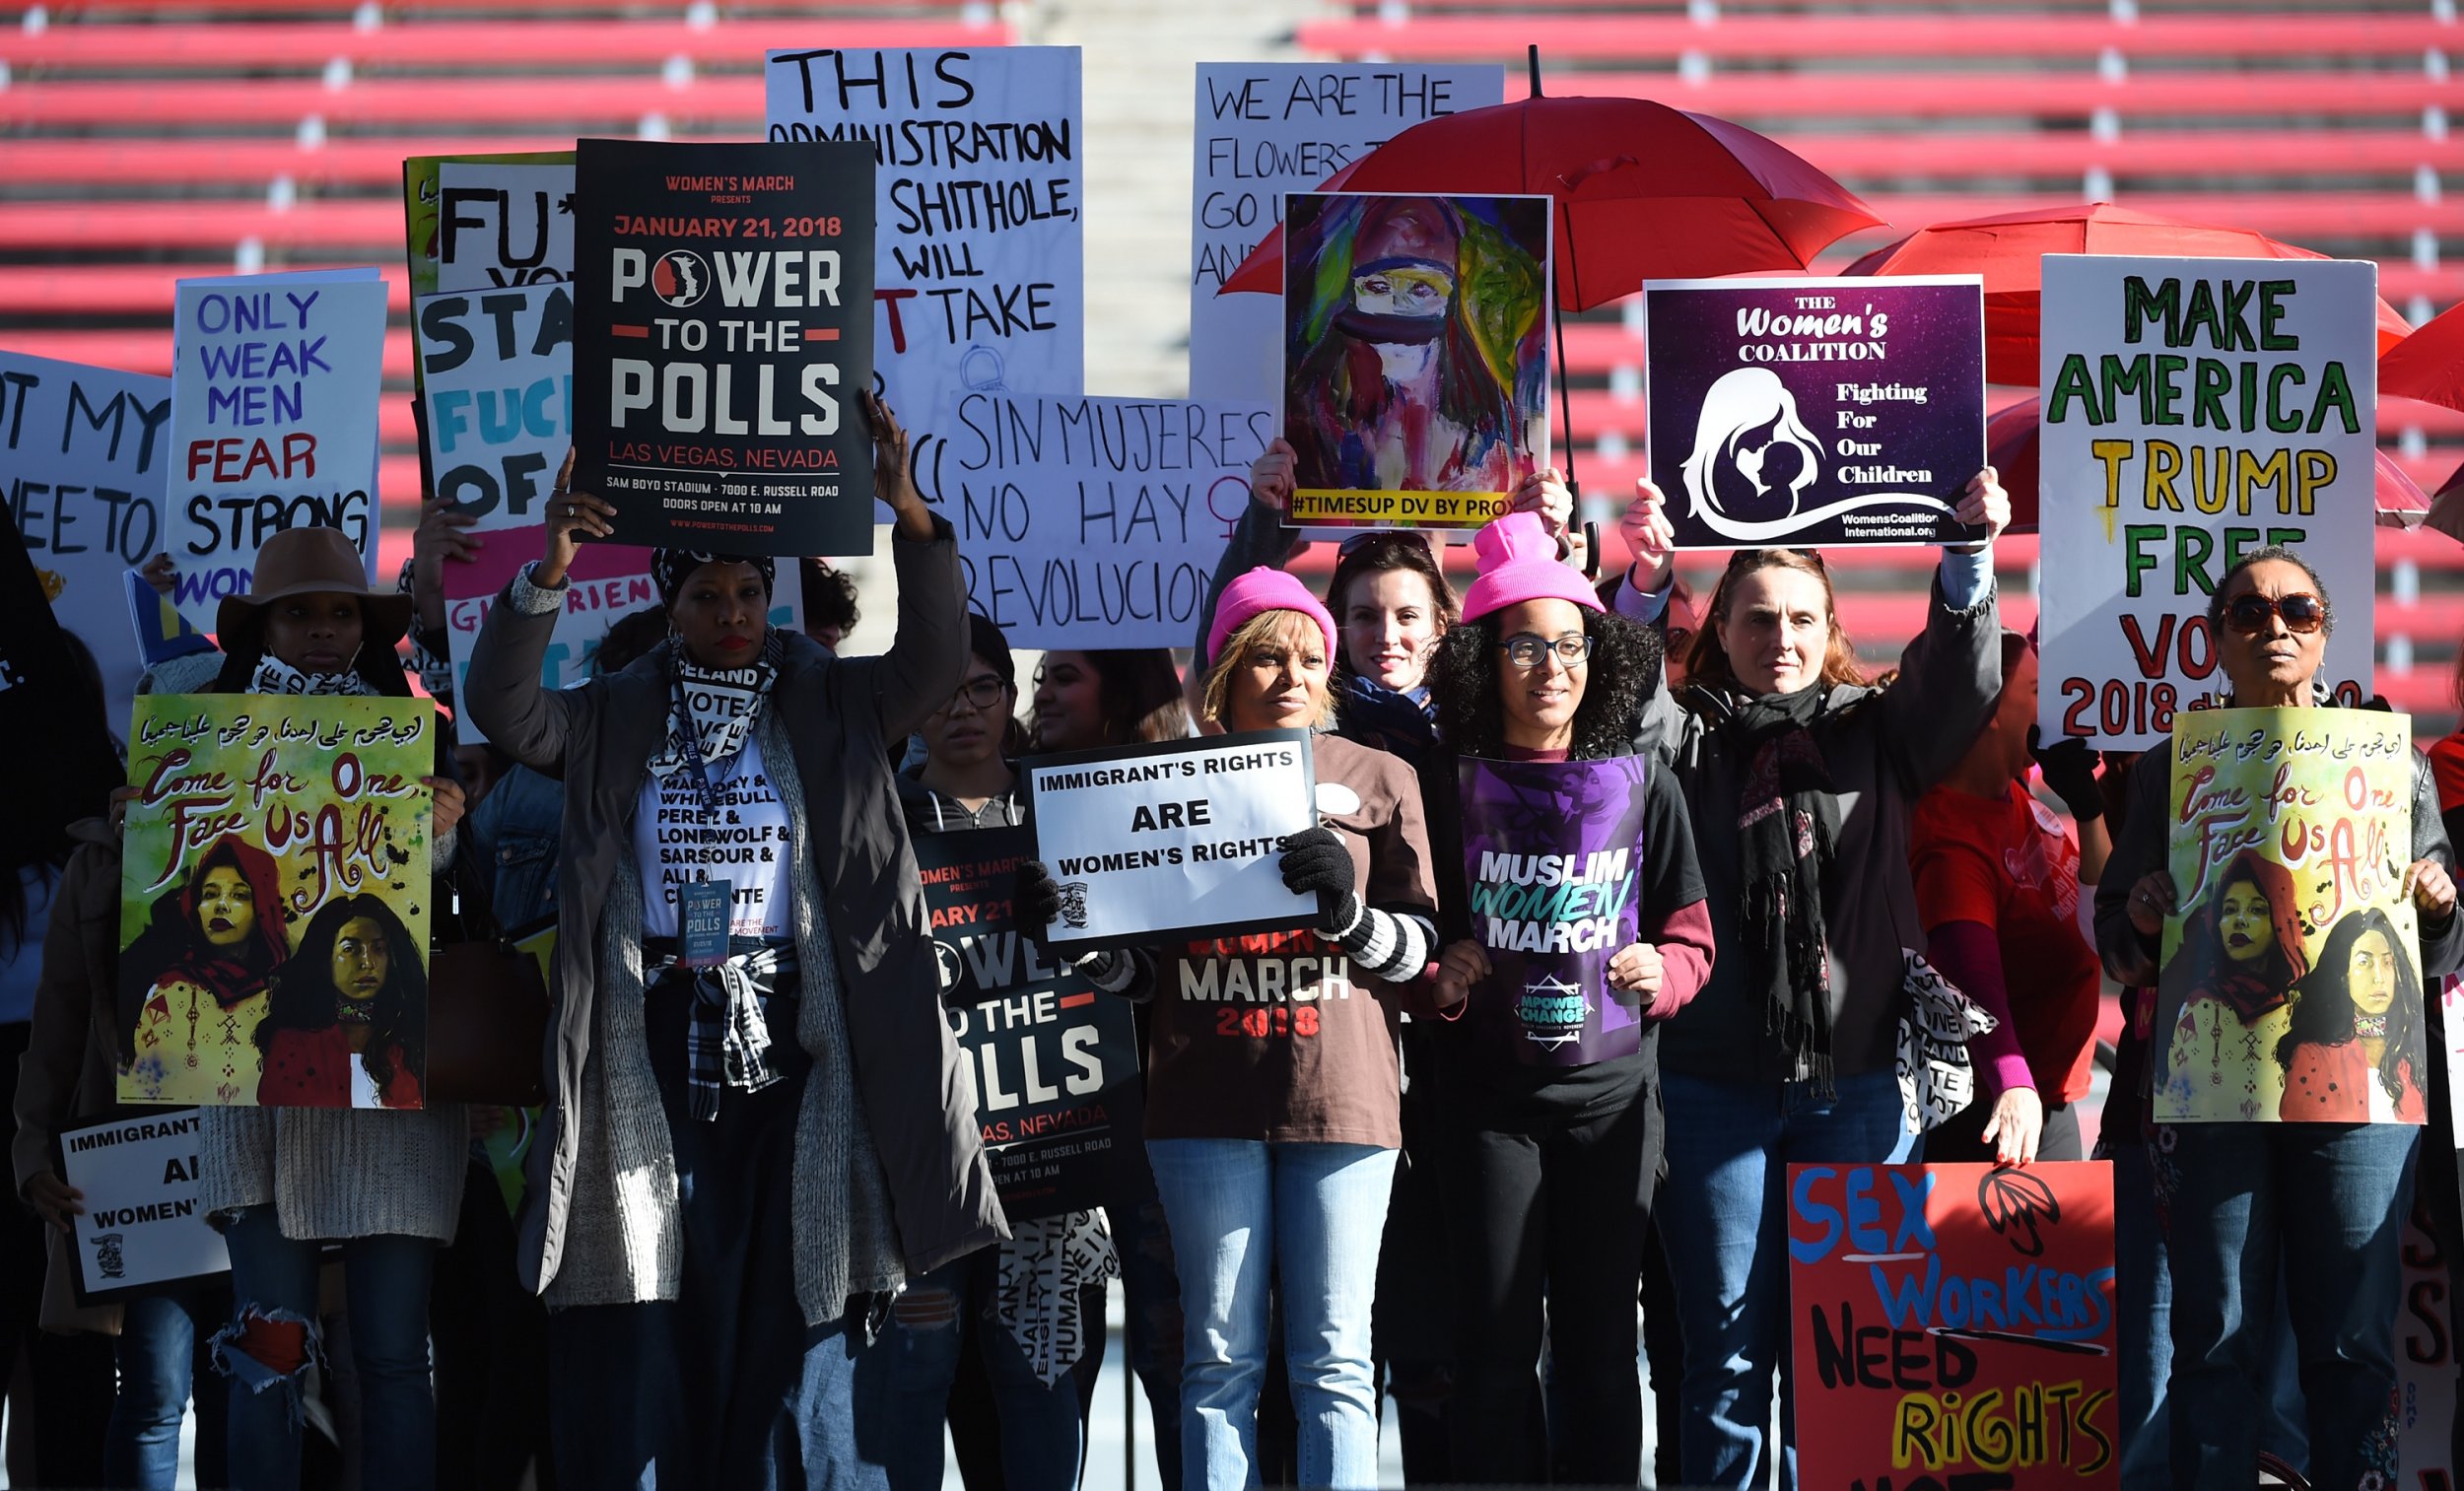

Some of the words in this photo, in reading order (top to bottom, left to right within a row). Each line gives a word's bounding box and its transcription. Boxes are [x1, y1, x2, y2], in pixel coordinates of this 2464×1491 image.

[772, 49, 975, 113] THIS
[1208, 78, 1270, 120] WE
[1283, 75, 1361, 120] ARE
[1373, 73, 1455, 119] THE
[1209, 137, 1352, 179] FLOWERS
[665, 175, 737, 191] WOMEN'S
[742, 175, 794, 191] MARCH
[711, 195, 751, 204] PRESENTS
[614, 216, 737, 237] JANUARY
[742, 218, 777, 239] 21,
[784, 217, 842, 237] 2018
[890, 178, 1077, 237] SHITHOLE,
[1201, 192, 1258, 229] GO
[892, 241, 985, 281] WILL
[197, 290, 319, 334] ONLY
[925, 283, 1058, 345] TAKE
[1737, 304, 1888, 338] Women's
[1795, 297, 1835, 309] THE
[2124, 276, 2299, 352] MAKE
[421, 287, 573, 374] STA
[654, 318, 708, 353] TO
[719, 320, 800, 352] THE
[200, 335, 331, 380] WEAK
[1739, 342, 1886, 362] COALITION
[208, 382, 303, 428] MEN
[611, 358, 840, 436] POLLS
[1836, 383, 1928, 405] Fighting
[2047, 354, 2361, 434] AMERICA
[62, 380, 171, 475] MY
[958, 394, 1042, 470] SIN
[1057, 399, 1272, 472] MUJERES
[1836, 411, 1877, 429] For
[187, 433, 317, 483] FEAR
[609, 441, 651, 463] LAS
[657, 444, 738, 469] VEGAS,
[746, 448, 839, 469] NEVADA
[1837, 440, 1882, 456] Our
[606, 476, 629, 489] SAM
[632, 478, 661, 491] BOYD
[663, 480, 712, 494] STADIUM
[750, 485, 761, 497] E.
[763, 486, 808, 498] RUSSELL
[811, 486, 840, 497] ROAD
[1837, 466, 1933, 484] Children
[2091, 439, 2339, 515] TRUMP
[187, 490, 369, 556] STRONG
[663, 499, 698, 511] DOORS
[701, 501, 728, 512] OPEN
[731, 502, 746, 513] AT
[750, 503, 761, 514] 10
[764, 503, 782, 514] AM
[962, 483, 1030, 542] NO
[1078, 481, 1191, 544] HAY
[1293, 496, 1395, 514] #TIMESUP
[1402, 499, 1429, 514] DV
[1436, 501, 1460, 515] BY
[1845, 526, 1936, 538] International.org
[2119, 613, 2219, 680] VO
[2061, 677, 2178, 737] 2018
[138, 747, 236, 807] Come
[243, 747, 308, 809] for
[331, 751, 421, 802] One,
[1040, 761, 1197, 792] IMMIGRANT'S
[1203, 751, 1293, 775] RIGHTS
[659, 789, 778, 806] WHIEBULL
[2177, 765, 2252, 828] Come
[2259, 761, 2324, 825] for
[657, 809, 720, 825] PEREZ
[725, 810, 741, 825] &
[777, 826, 790, 841] &
[1131, 799, 1211, 833] ARE
[145, 791, 250, 893] Face
[264, 802, 314, 856] Us
[293, 801, 390, 916] All
[660, 847, 754, 864] SARSOUR
[760, 847, 774, 862] &
[921, 862, 975, 885] OMEN'S
[978, 854, 1030, 876] MARC
[1059, 847, 1183, 876] WOMEN'S
[1192, 835, 1289, 862] RIGHTS
[1478, 847, 1629, 887] MUSLIM
[2178, 808, 2266, 913] Face
[2280, 817, 2326, 870] Us
[2310, 817, 2387, 926] All
[662, 869, 690, 884] ALI
[1471, 868, 1635, 929] WOMEN
[687, 917, 720, 933] POLLS
[1486, 914, 1620, 954] MARCH
[1179, 956, 1349, 1002] MARCH
[977, 990, 1058, 1033] THE
[1215, 1005, 1321, 1038] 2018
[1520, 1007, 1585, 1025] CHANGE
[1521, 993, 1585, 1010] MPOWER
[70, 1117, 200, 1153] IMMIGRANT
[983, 1120, 1015, 1142] AS,
[1019, 1105, 1109, 1138] NEVADA
[1041, 1143, 1082, 1161] RUSSELL
[1084, 1137, 1112, 1153] ROAD
[992, 1173, 1011, 1186] PEN
[1013, 1171, 1027, 1183] AT
[1044, 1164, 1061, 1178] AM
[93, 1197, 197, 1229] WOMEN'
[1789, 1166, 1937, 1264] SEX
[1869, 1251, 2116, 1340] WORKERS
[1811, 1300, 1978, 1390] NEED
